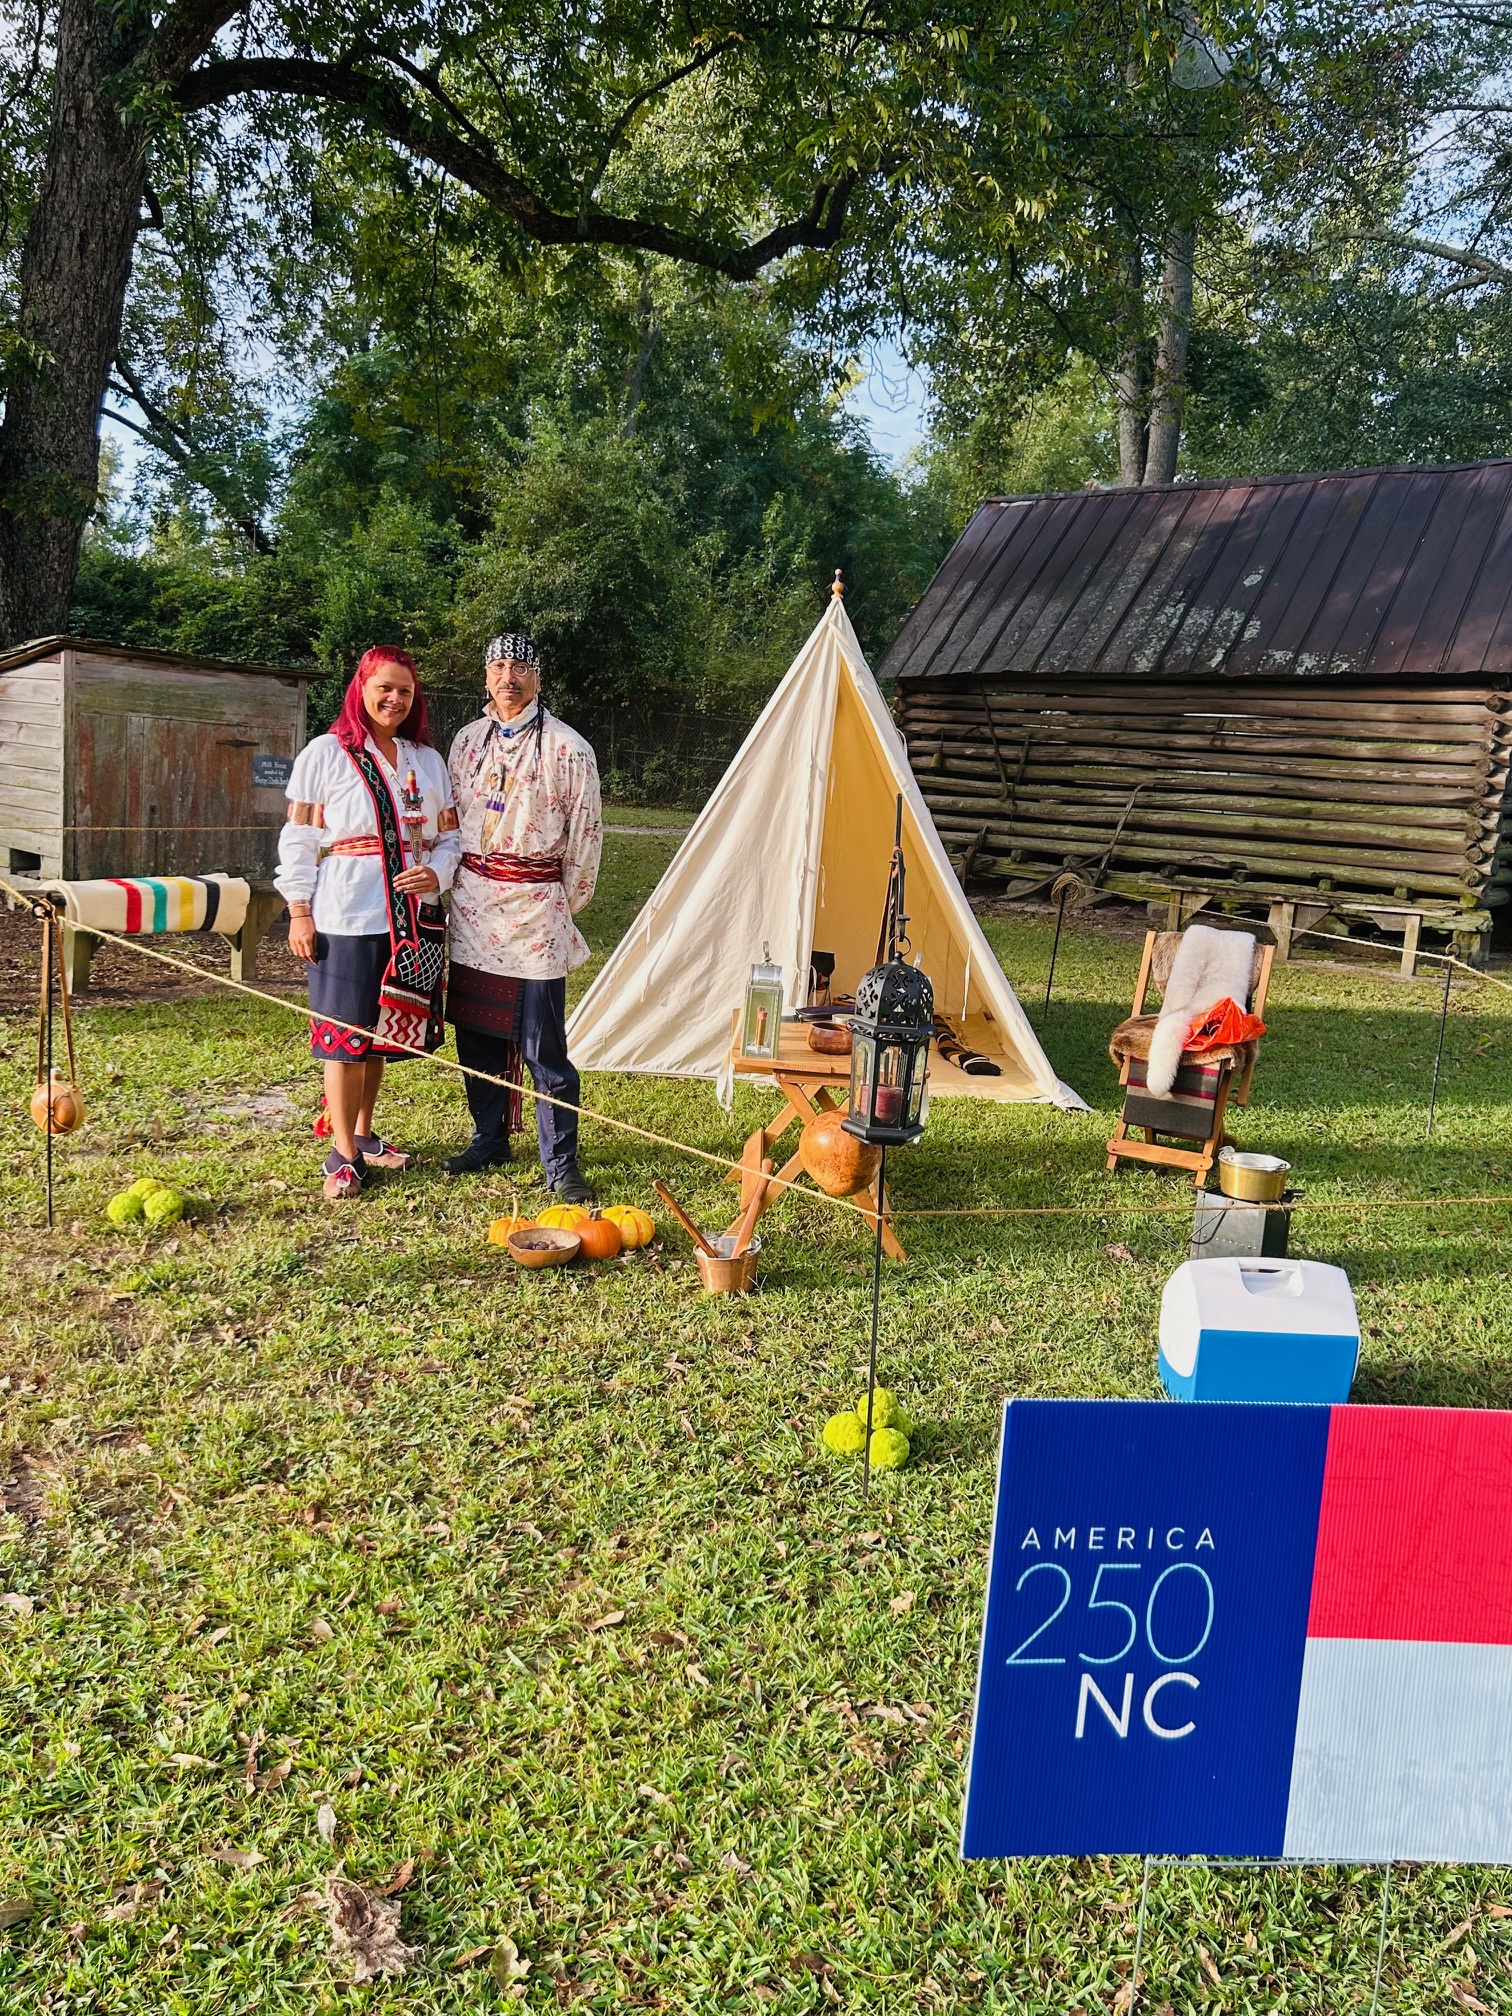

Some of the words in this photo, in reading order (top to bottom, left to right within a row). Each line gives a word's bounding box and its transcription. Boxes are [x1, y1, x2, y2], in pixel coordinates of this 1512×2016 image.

[1021, 1526, 1215, 1550] AMERICA
[1006, 1562, 1215, 1665] 250
[1075, 1671, 1201, 1739] NC
